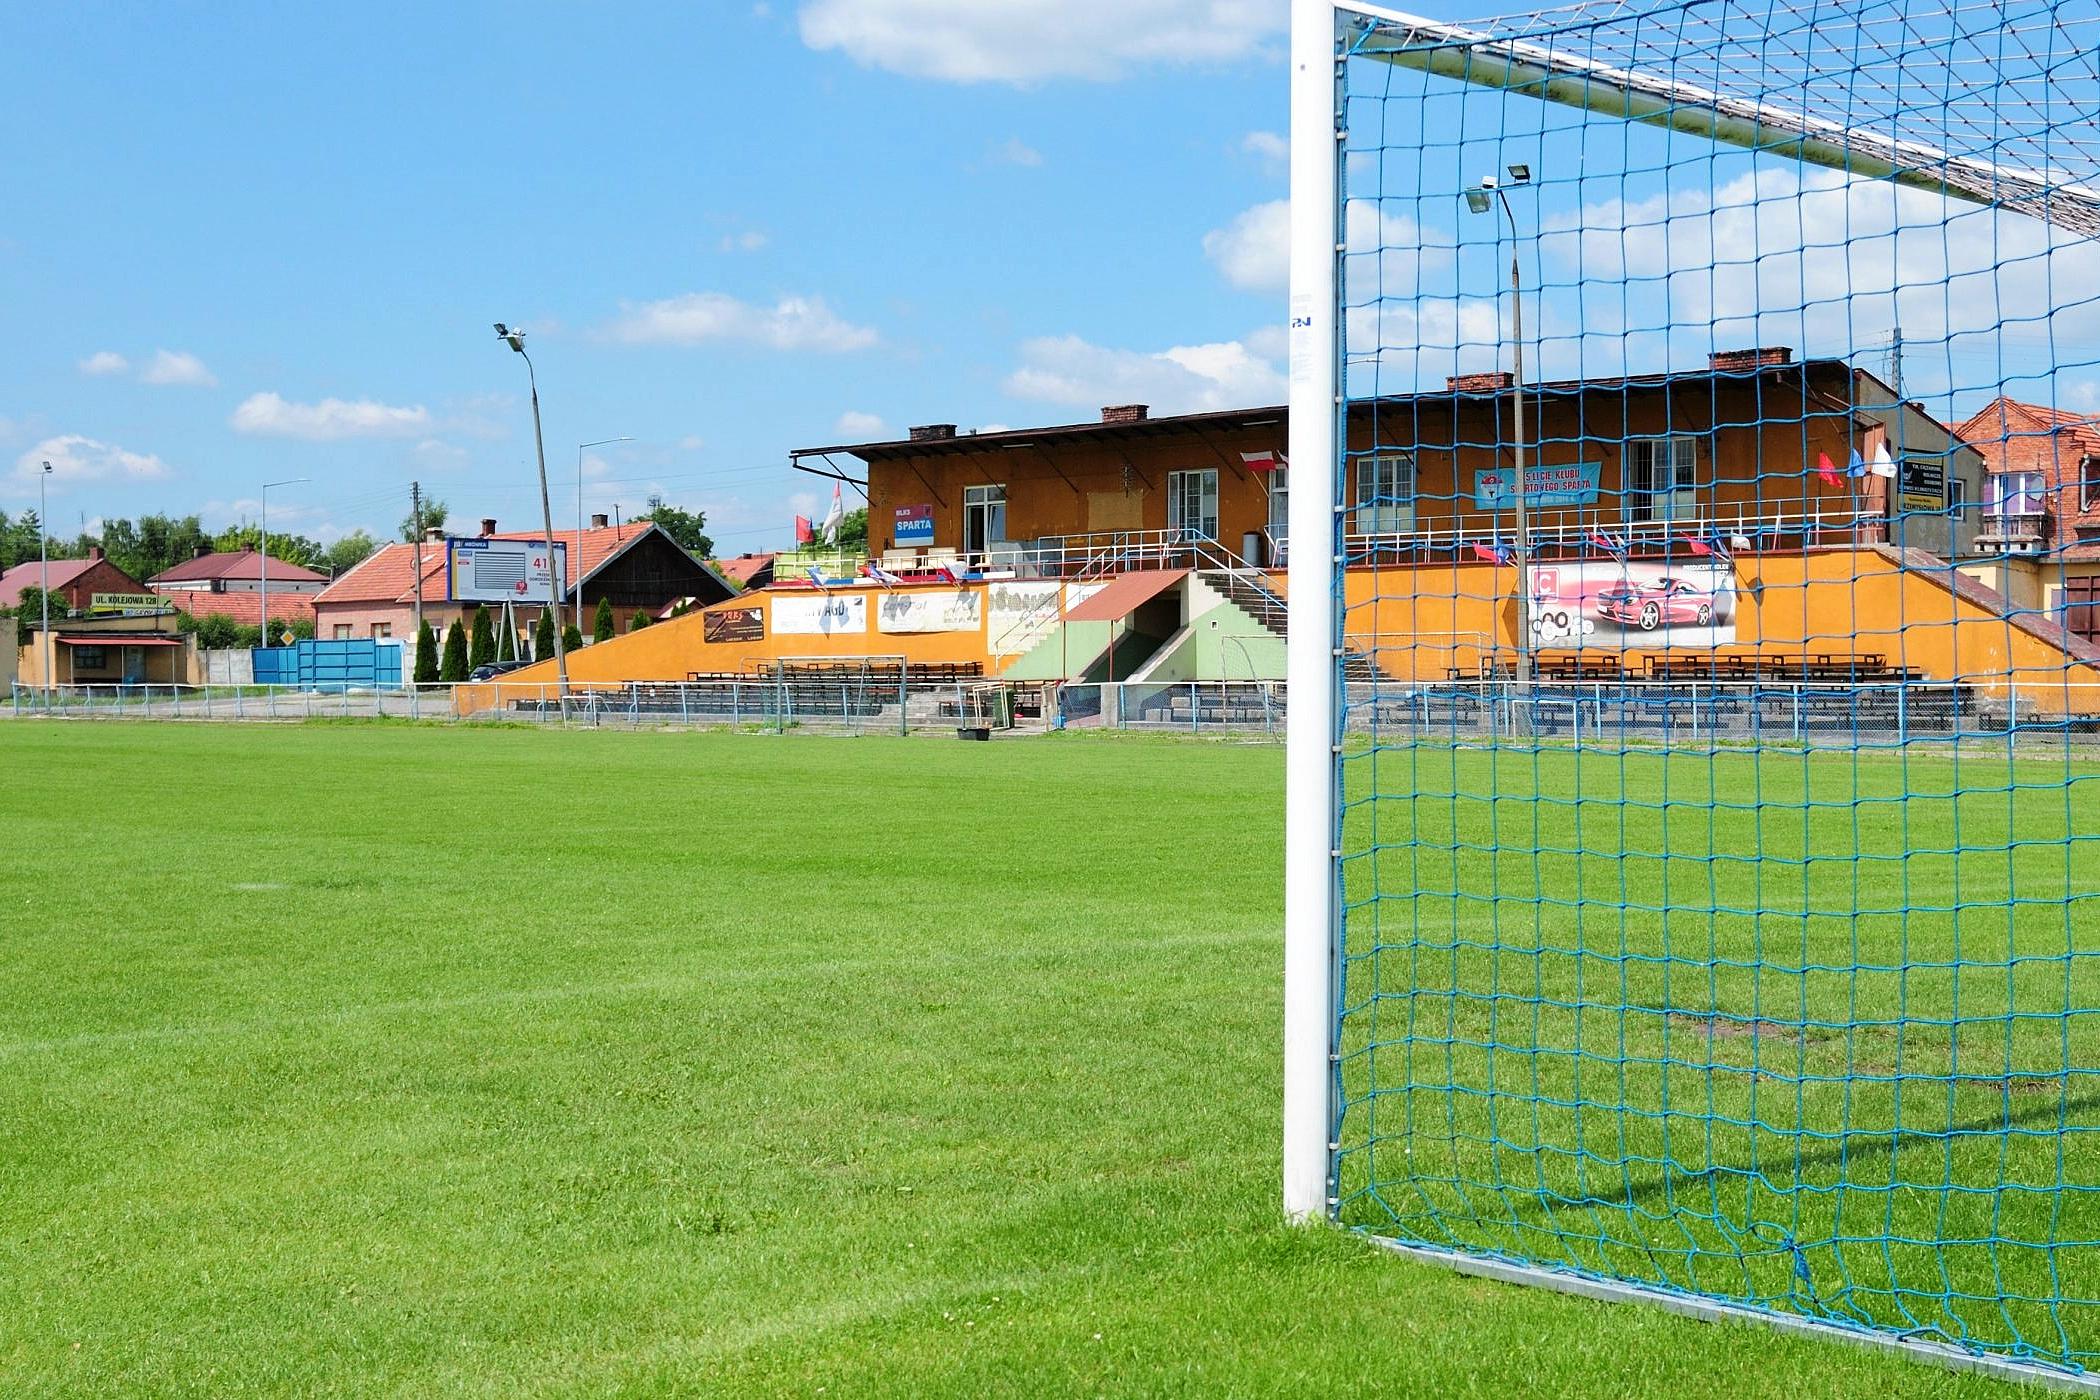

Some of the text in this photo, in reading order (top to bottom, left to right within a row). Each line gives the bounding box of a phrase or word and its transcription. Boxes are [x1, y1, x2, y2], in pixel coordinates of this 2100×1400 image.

[1555, 469, 1580, 479] KLUBU
[896, 519, 932, 531] SPARTA
[95, 595, 107, 604] UL.
[108, 596, 144, 605] KOLEJOWA
